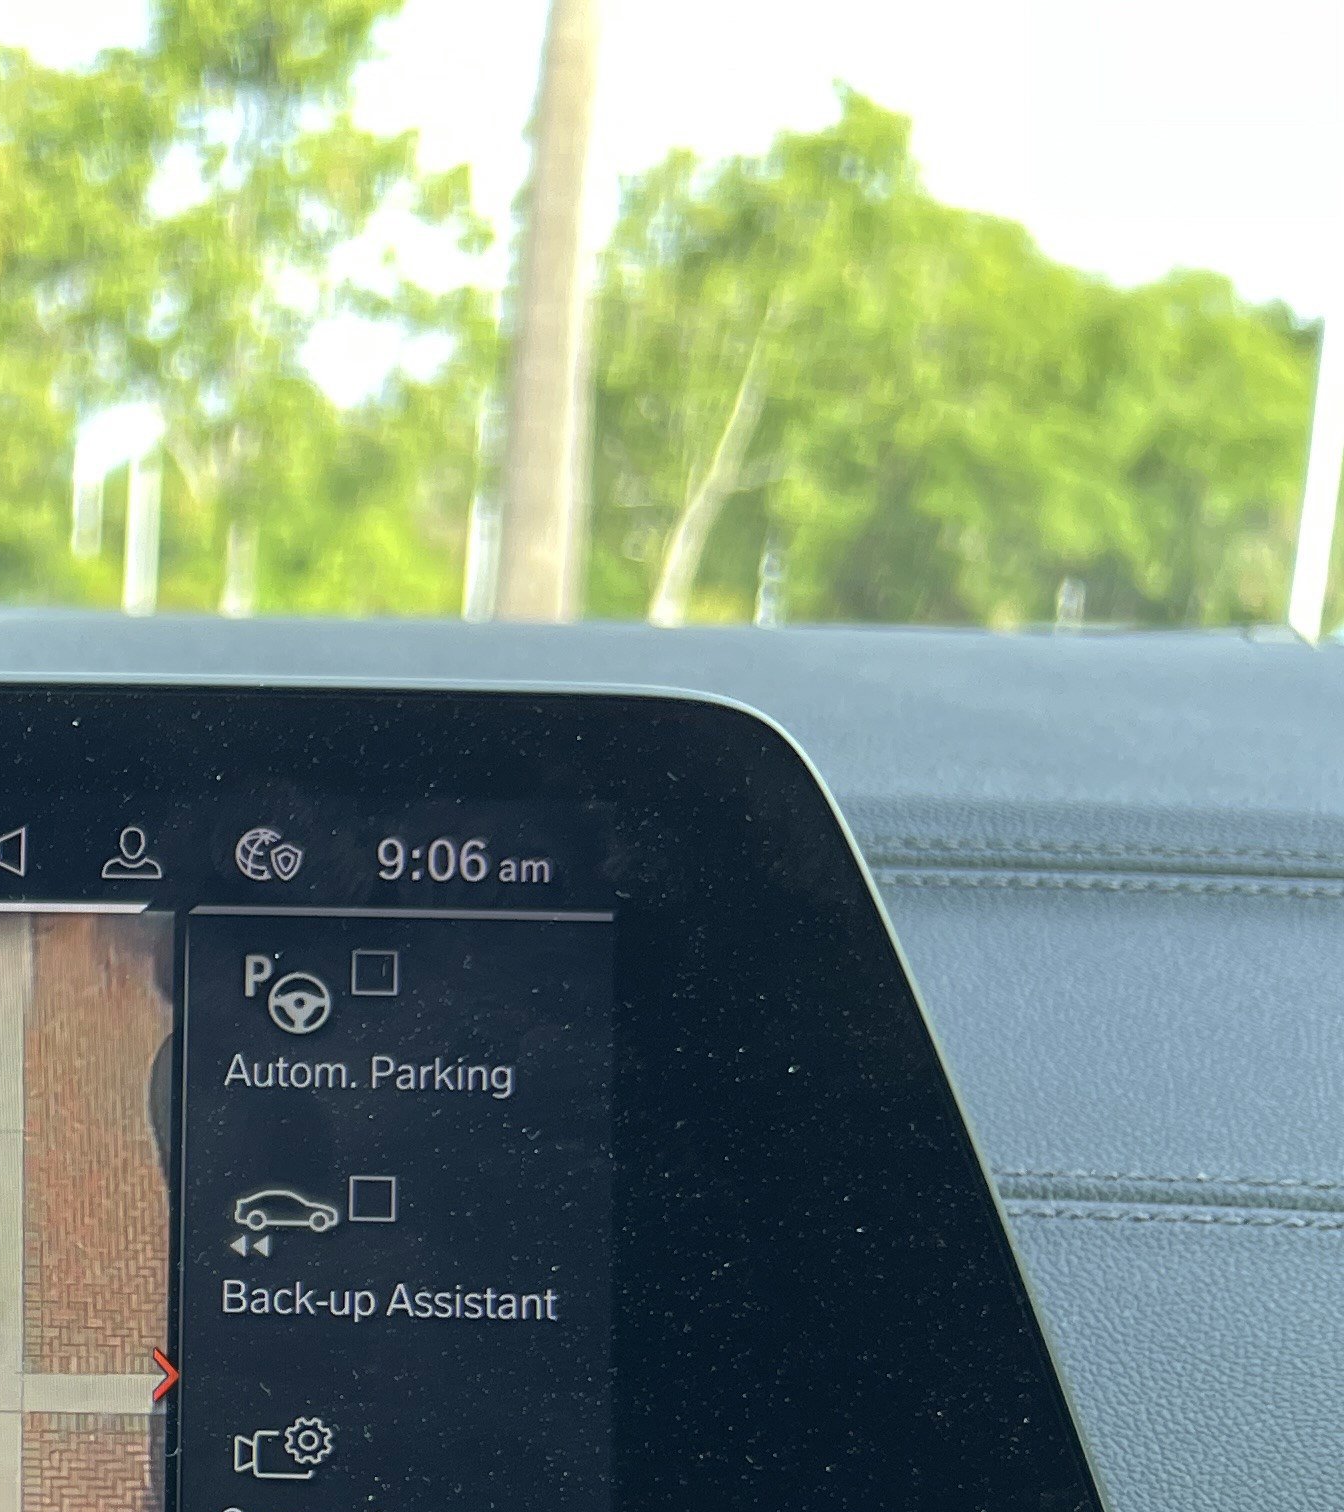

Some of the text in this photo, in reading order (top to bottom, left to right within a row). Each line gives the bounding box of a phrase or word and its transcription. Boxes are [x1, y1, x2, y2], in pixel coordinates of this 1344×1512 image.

[376, 838, 551, 884] 9:06 am
[243, 954, 272, 998] P
[224, 1053, 515, 1099] Autom. Parking
[221, 1279, 558, 1322] Back-up Assistant
